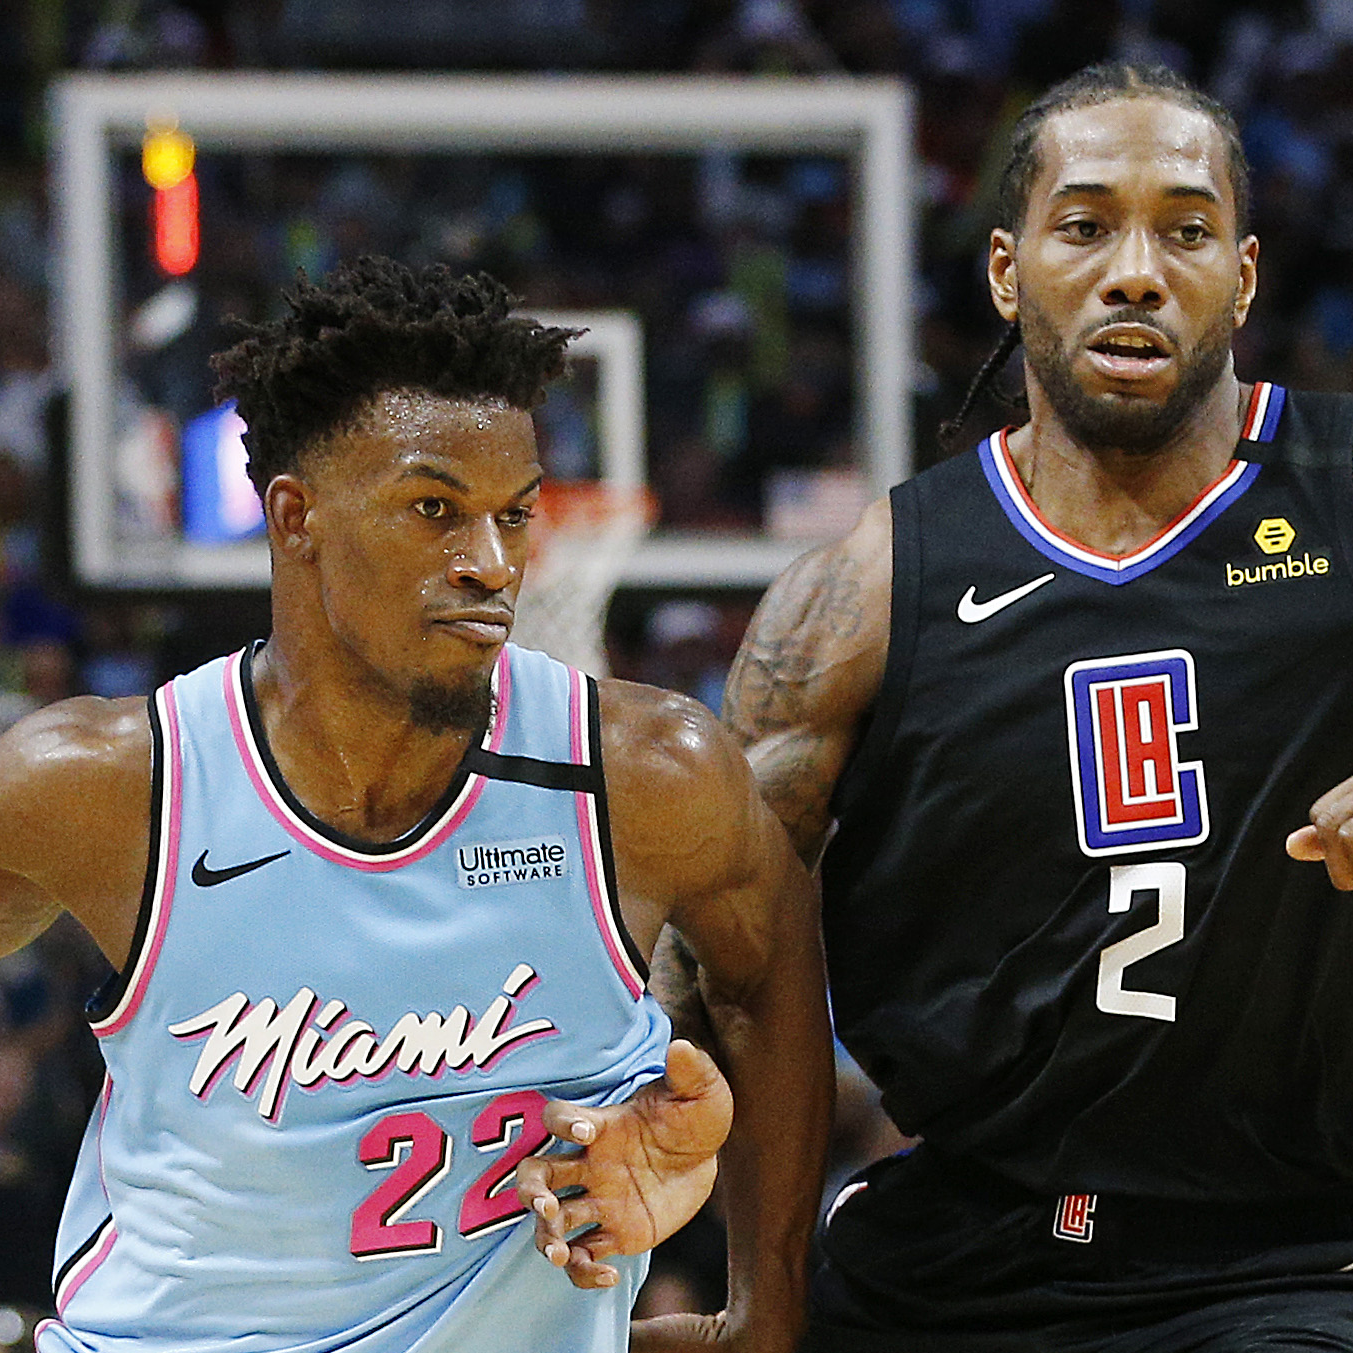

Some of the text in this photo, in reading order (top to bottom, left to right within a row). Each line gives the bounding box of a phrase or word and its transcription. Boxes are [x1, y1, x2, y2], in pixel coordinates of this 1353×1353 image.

[1226, 553, 1330, 587] bumble
[458, 842, 565, 872] Ultimate
[466, 864, 563, 887] SOFTWARE
[1095, 861, 1187, 1023] 2
[167, 962, 560, 1124] Miami
[350, 1089, 557, 1263] 22
